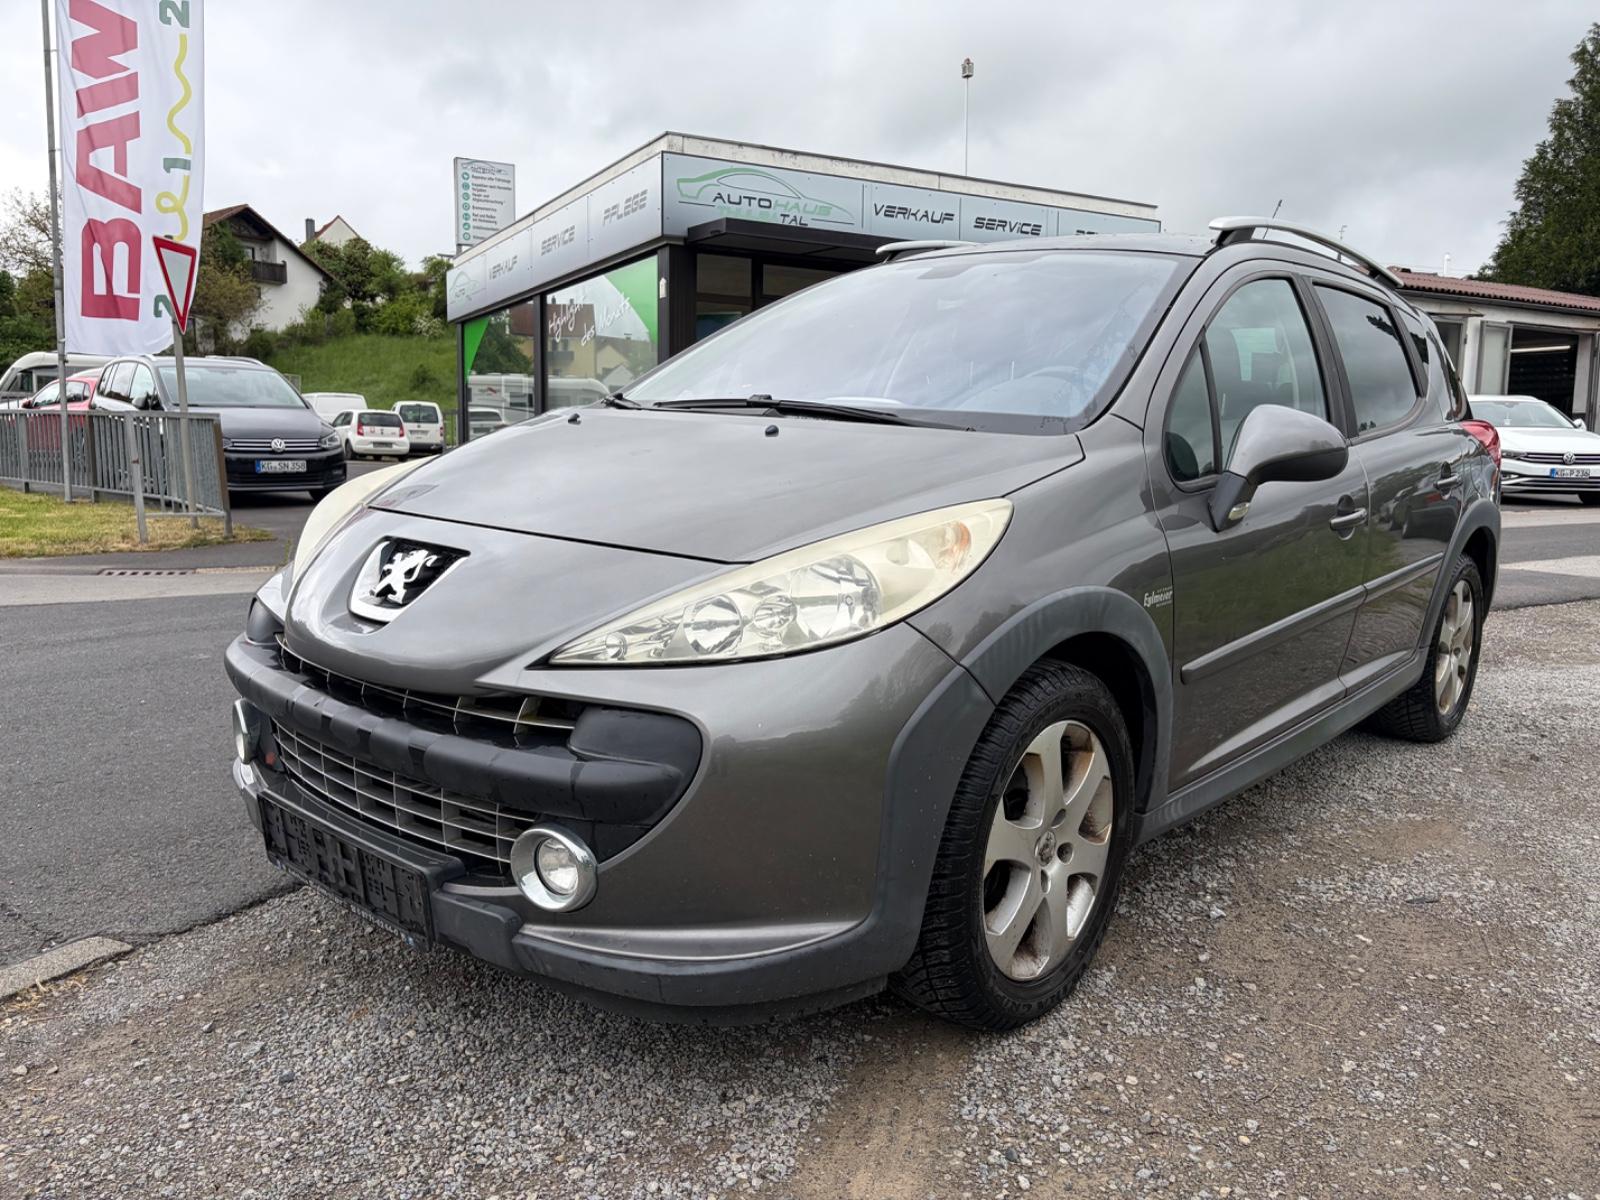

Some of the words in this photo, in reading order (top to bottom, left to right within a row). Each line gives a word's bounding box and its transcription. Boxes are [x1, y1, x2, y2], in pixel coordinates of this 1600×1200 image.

[159, 0, 190, 29] 2
[68, 0, 142, 321] BAW
[163, 157, 192, 173] 1
[712, 192, 833, 217] AUTOHAUS
[873, 203, 955, 225] VERKAUF
[973, 216, 1042, 236] SERVICE
[541, 224, 576, 256] SERVICE
